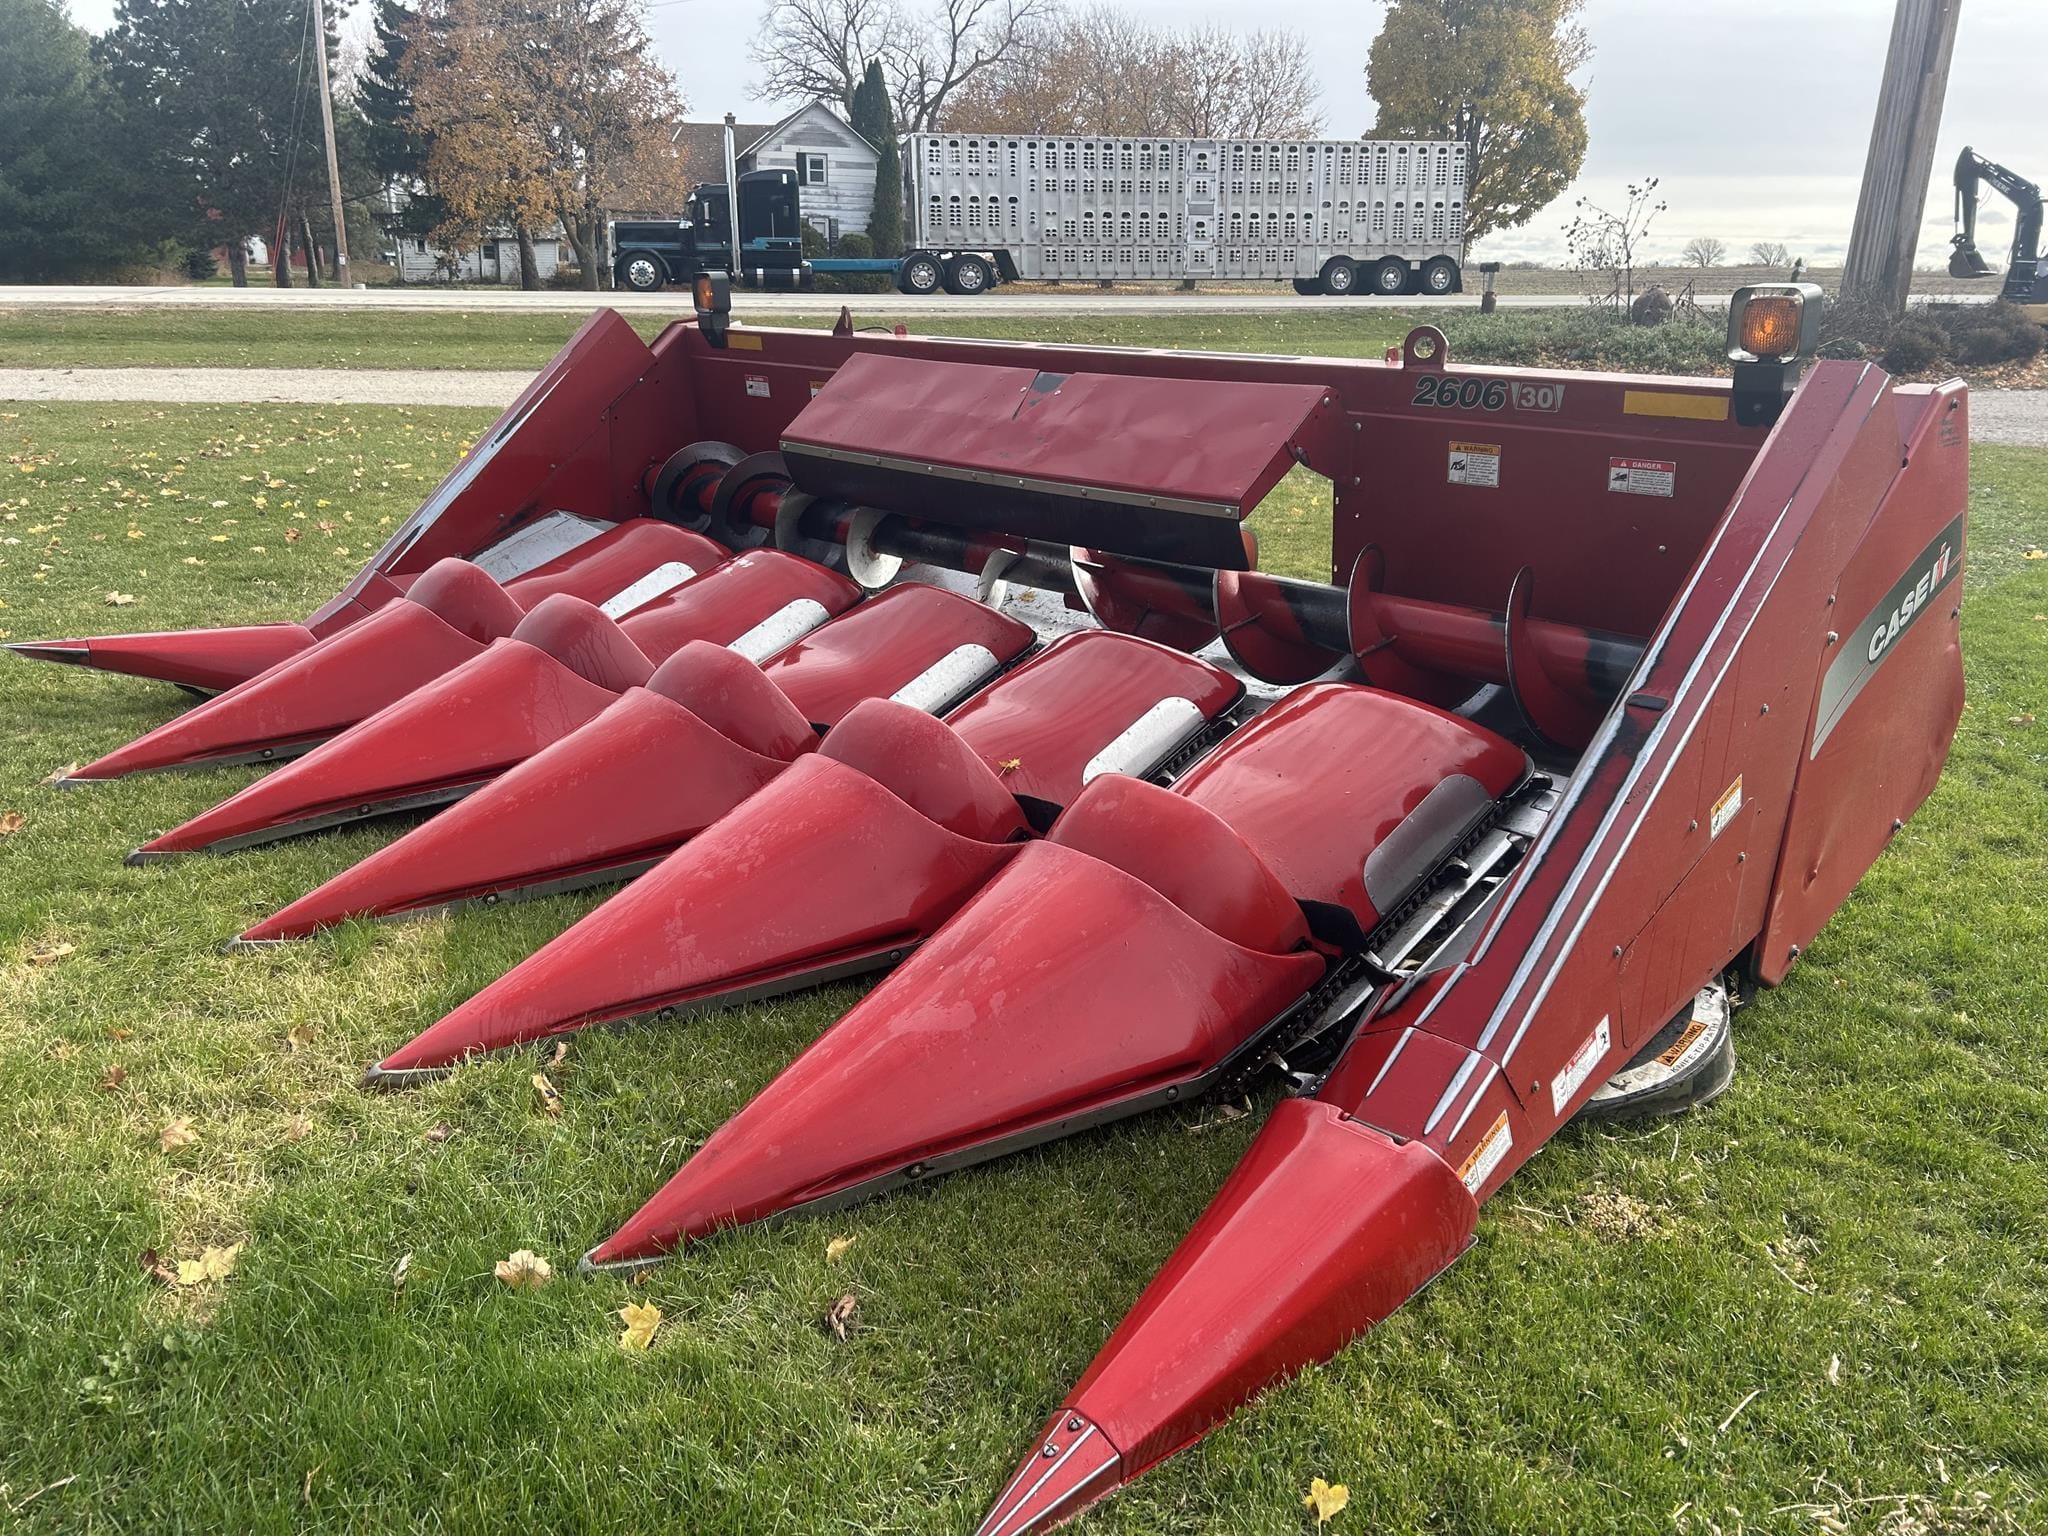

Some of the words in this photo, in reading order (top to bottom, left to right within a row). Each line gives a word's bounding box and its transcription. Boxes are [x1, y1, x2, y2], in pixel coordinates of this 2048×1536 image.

[1411, 375, 1509, 412] 2606
[1520, 386, 1553, 409] 30
[1632, 461, 1662, 470] DANGER
[1868, 570, 1931, 662] CASE
[1670, 1024, 1701, 1055] WARNING
[1472, 1123, 1501, 1161] WARNING
